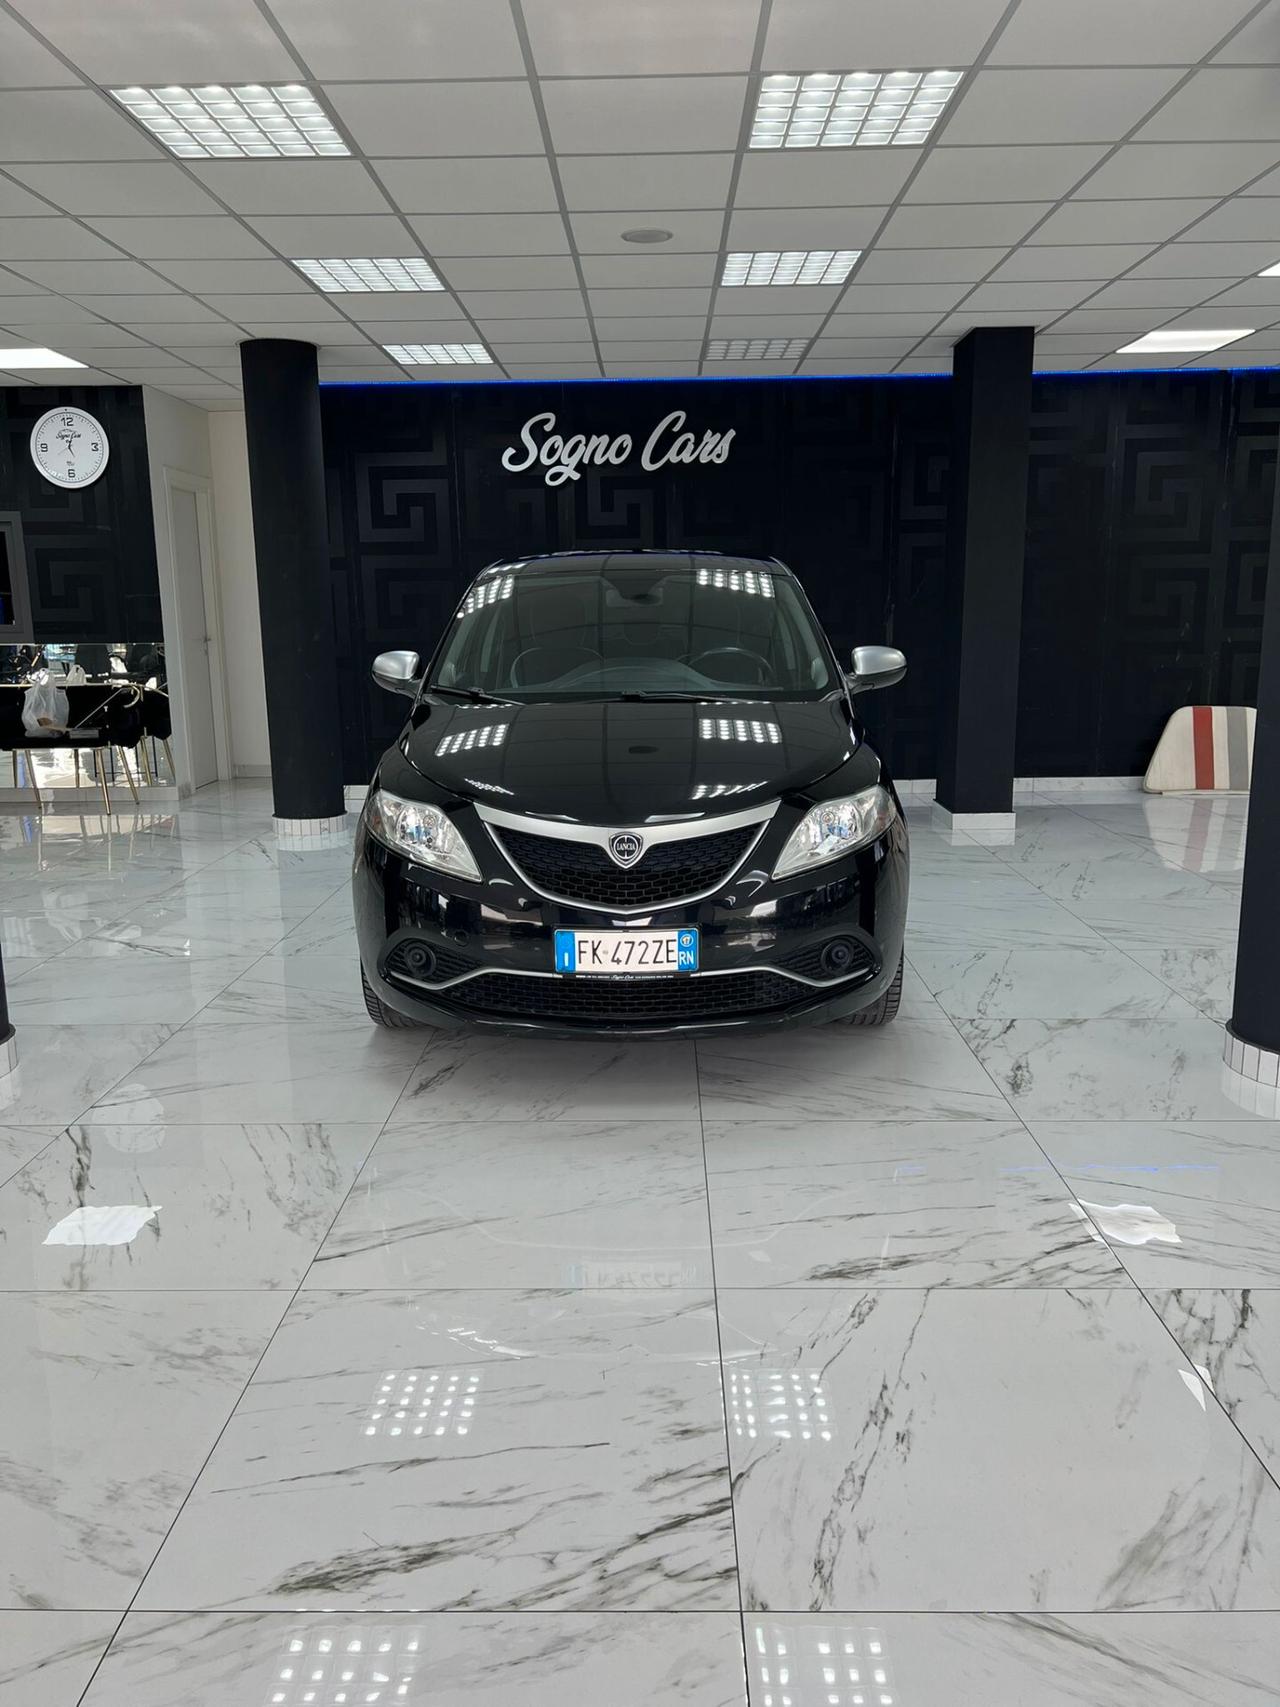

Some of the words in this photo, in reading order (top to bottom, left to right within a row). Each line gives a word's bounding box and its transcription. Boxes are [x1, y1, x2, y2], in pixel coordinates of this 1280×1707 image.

[60, 417, 74, 427] 12
[40, 443, 48, 452] 9
[91, 442, 99, 452] 3
[501, 412, 633, 486] Sogno
[641, 410, 737, 472] Cars
[67, 469, 76, 478] 6
[678, 949, 694, 966] RN
